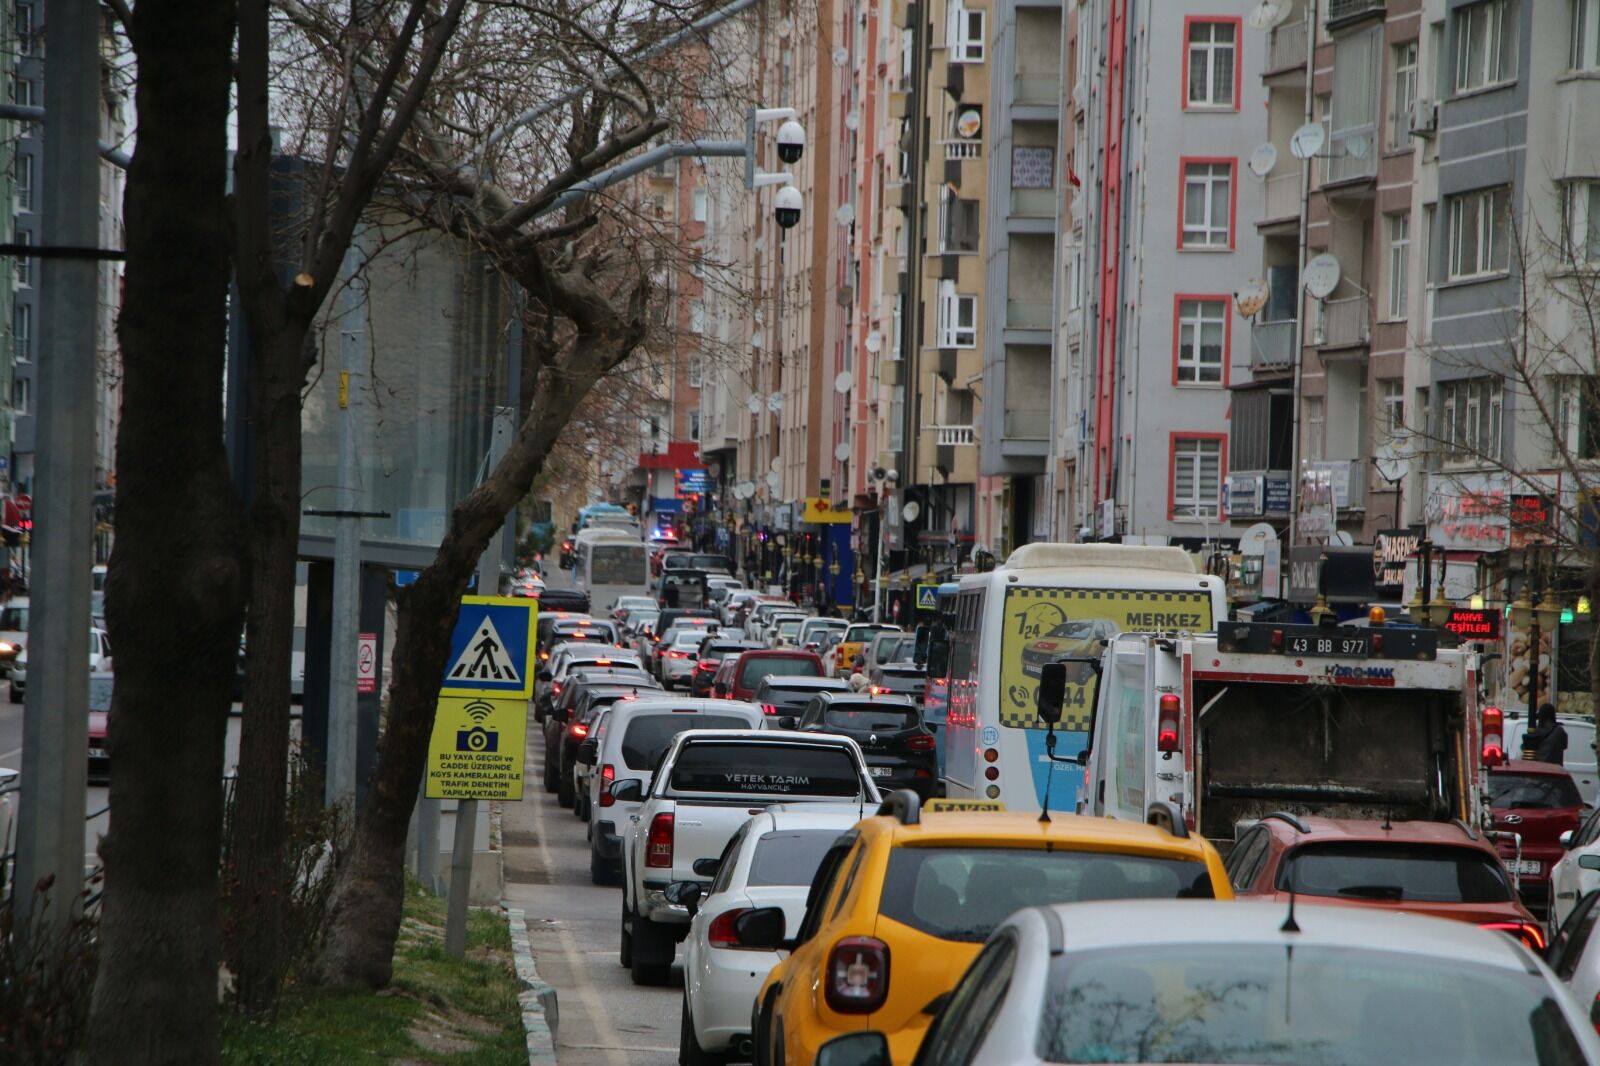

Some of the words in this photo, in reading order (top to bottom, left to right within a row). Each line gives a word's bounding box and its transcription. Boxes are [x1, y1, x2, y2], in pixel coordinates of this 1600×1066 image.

[1126, 612, 1201, 627] MERKEZ
[1453, 612, 1483, 622] KAHVE
[1293, 638, 1308, 652] 43
[1317, 639, 1332, 653] BB
[1342, 639, 1364, 654] 977
[440, 762, 469, 770] CADDE
[471, 762, 512, 771] ÜZERİNDE
[453, 771, 507, 780] KAMERALARI
[508, 772, 521, 780] İLE
[725, 773, 765, 783] YETEK
[768, 774, 810, 785] TARIM
[471, 780, 510, 789] DENETİMİ
[740, 783, 791, 792] HAYVANCILIK
[441, 789, 508, 798] YAPILMAKTADIR
